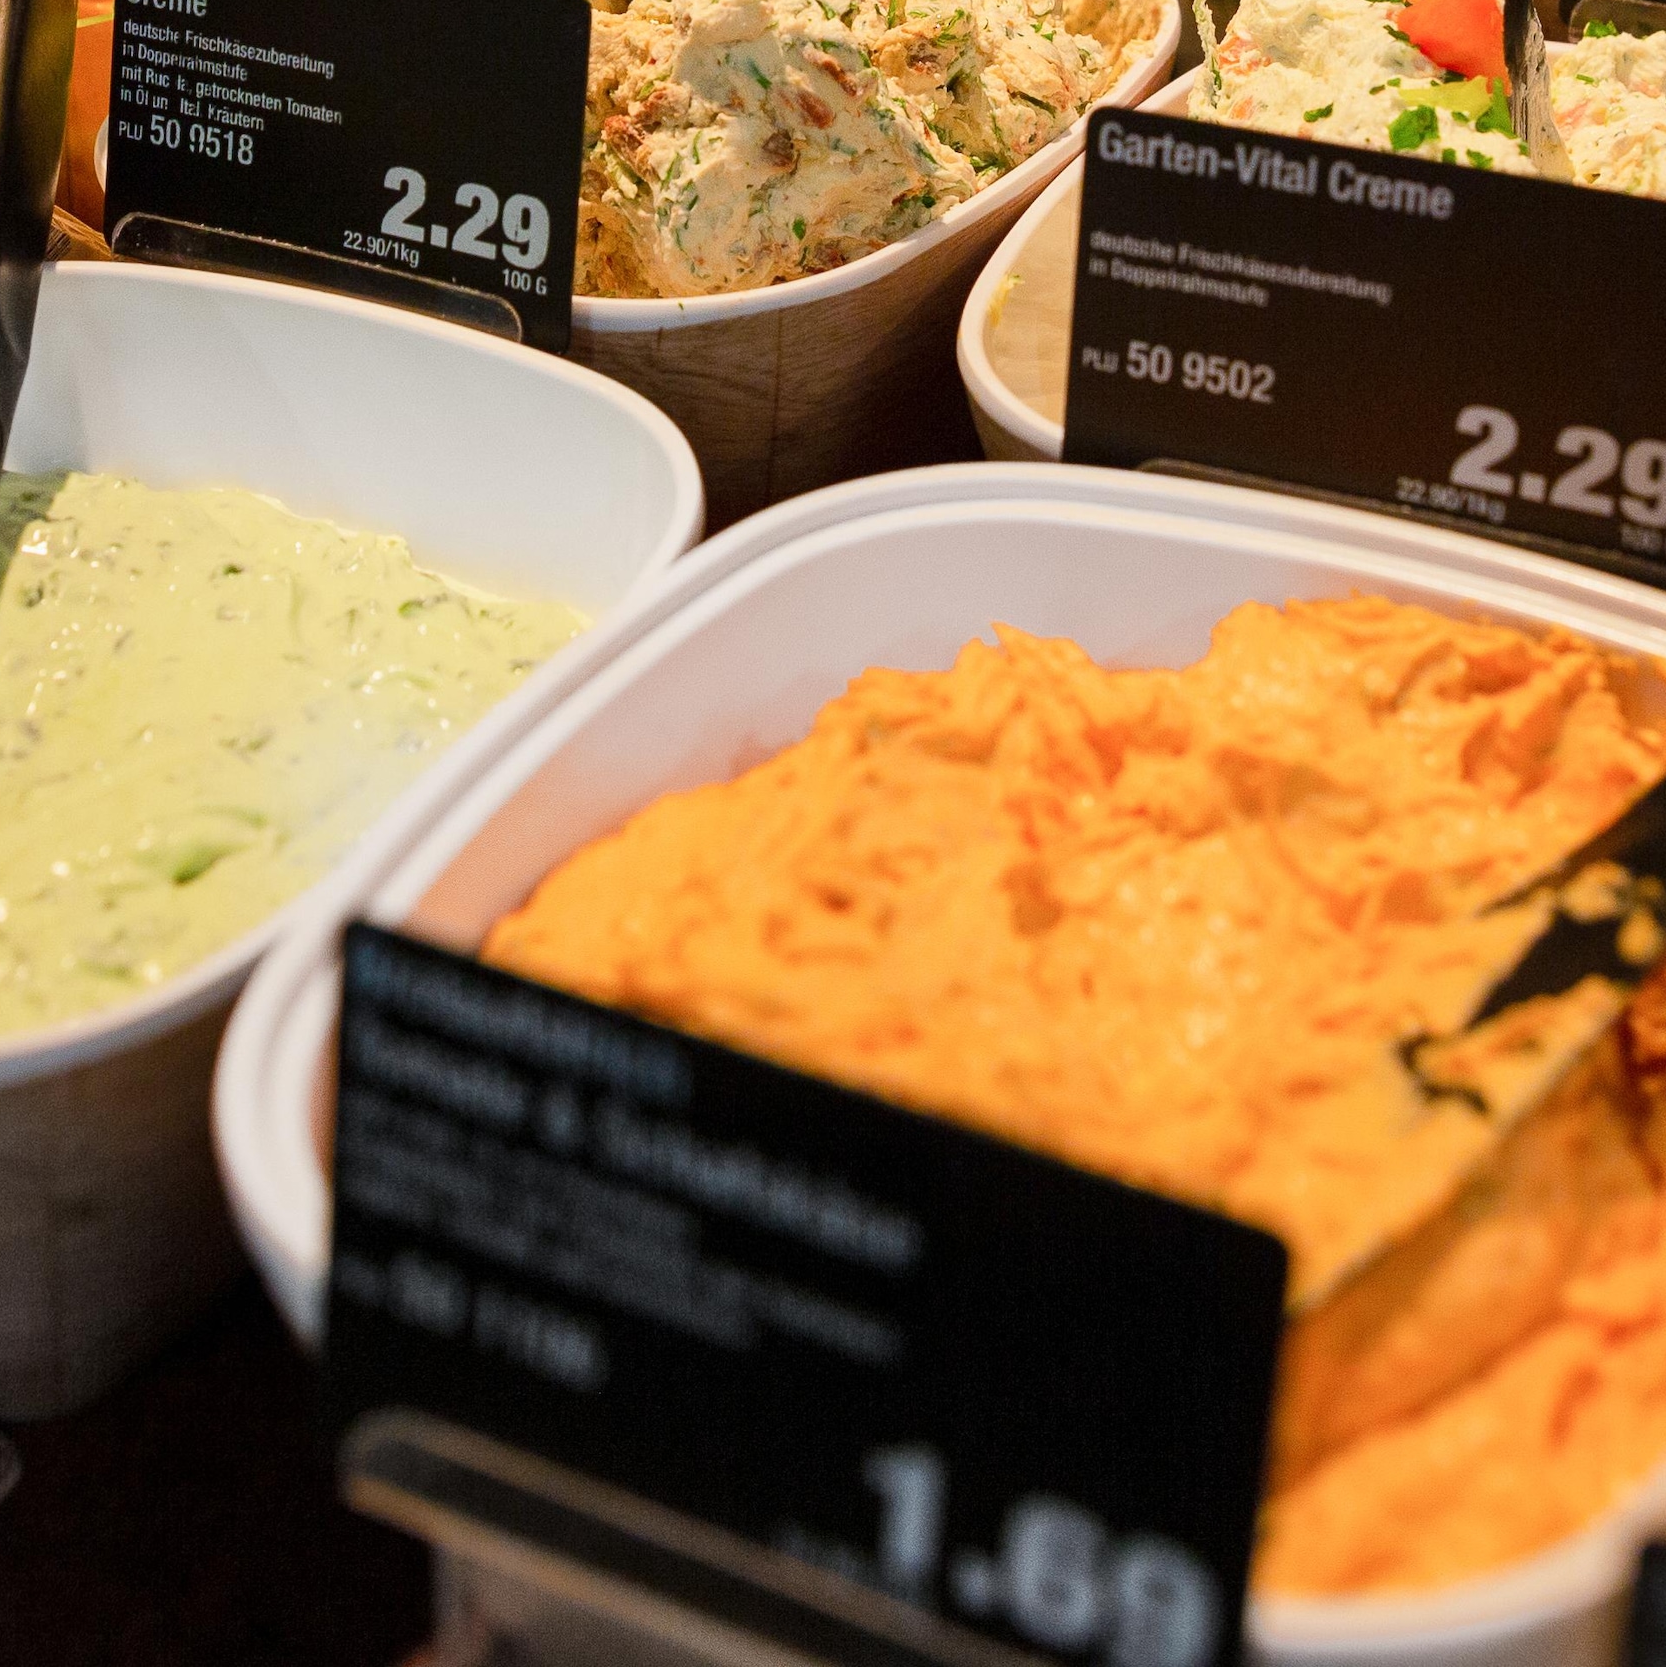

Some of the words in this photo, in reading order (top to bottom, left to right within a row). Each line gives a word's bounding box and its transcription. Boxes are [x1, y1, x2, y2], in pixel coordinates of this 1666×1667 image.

[122, 40, 135, 57] in
[185, 28, 335, 79] Frischkäsezubereitung
[120, 87, 133, 103] in
[136, 86, 149, 106] Öl
[208, 103, 265, 131] Kräutern
[121, 65, 143, 84] mit
[195, 78, 283, 112] getrockneten
[284, 97, 343, 126] Tomaten
[118, 121, 143, 142] PLU
[149, 115, 182, 151] 50
[188, 123, 254, 166] 9518
[1097, 121, 1319, 198] Garten-Vital
[1330, 162, 1456, 222] Creme
[380, 165, 551, 271] 2.29
[342, 229, 420, 269] 22.90/1kg
[501, 268, 531, 292] 100
[535, 275, 548, 296] G
[1125, 340, 1173, 384] 50
[1181, 349, 1276, 406] 9502
